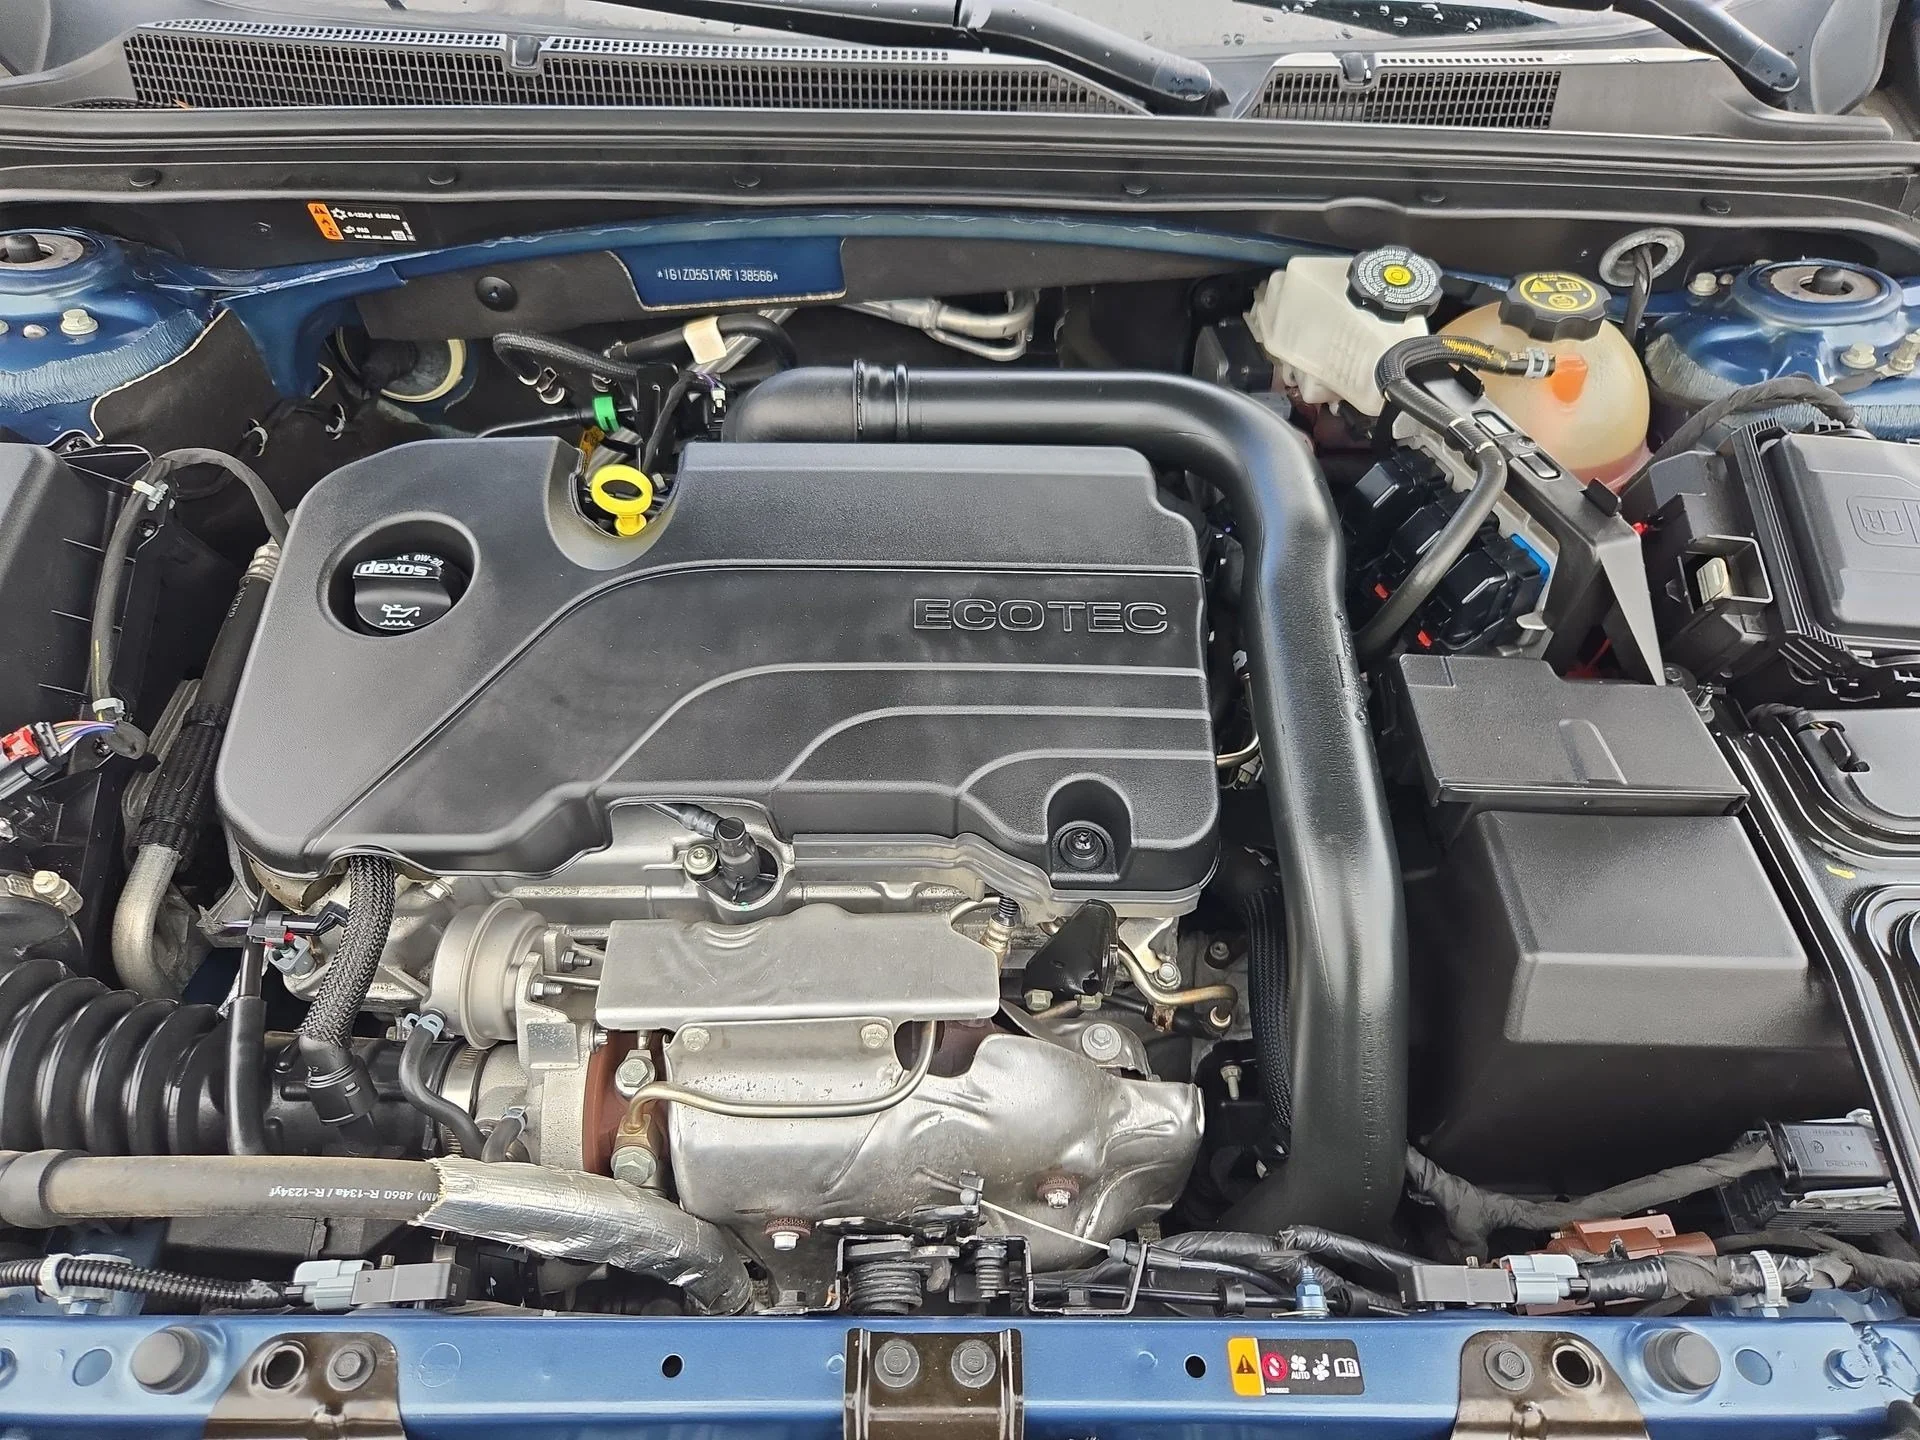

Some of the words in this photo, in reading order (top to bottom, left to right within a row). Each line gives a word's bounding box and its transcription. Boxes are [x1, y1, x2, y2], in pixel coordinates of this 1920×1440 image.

[413, 553, 444, 567] 0W-20
[360, 561, 431, 576] dexos
[913, 598, 1168, 634] ECOTEC
[269, 1186, 324, 1198] R-1234yf
[335, 1188, 380, 1199] R-134a
[384, 1190, 414, 1201] 4860
[1291, 1371, 1310, 1380] AUTO
